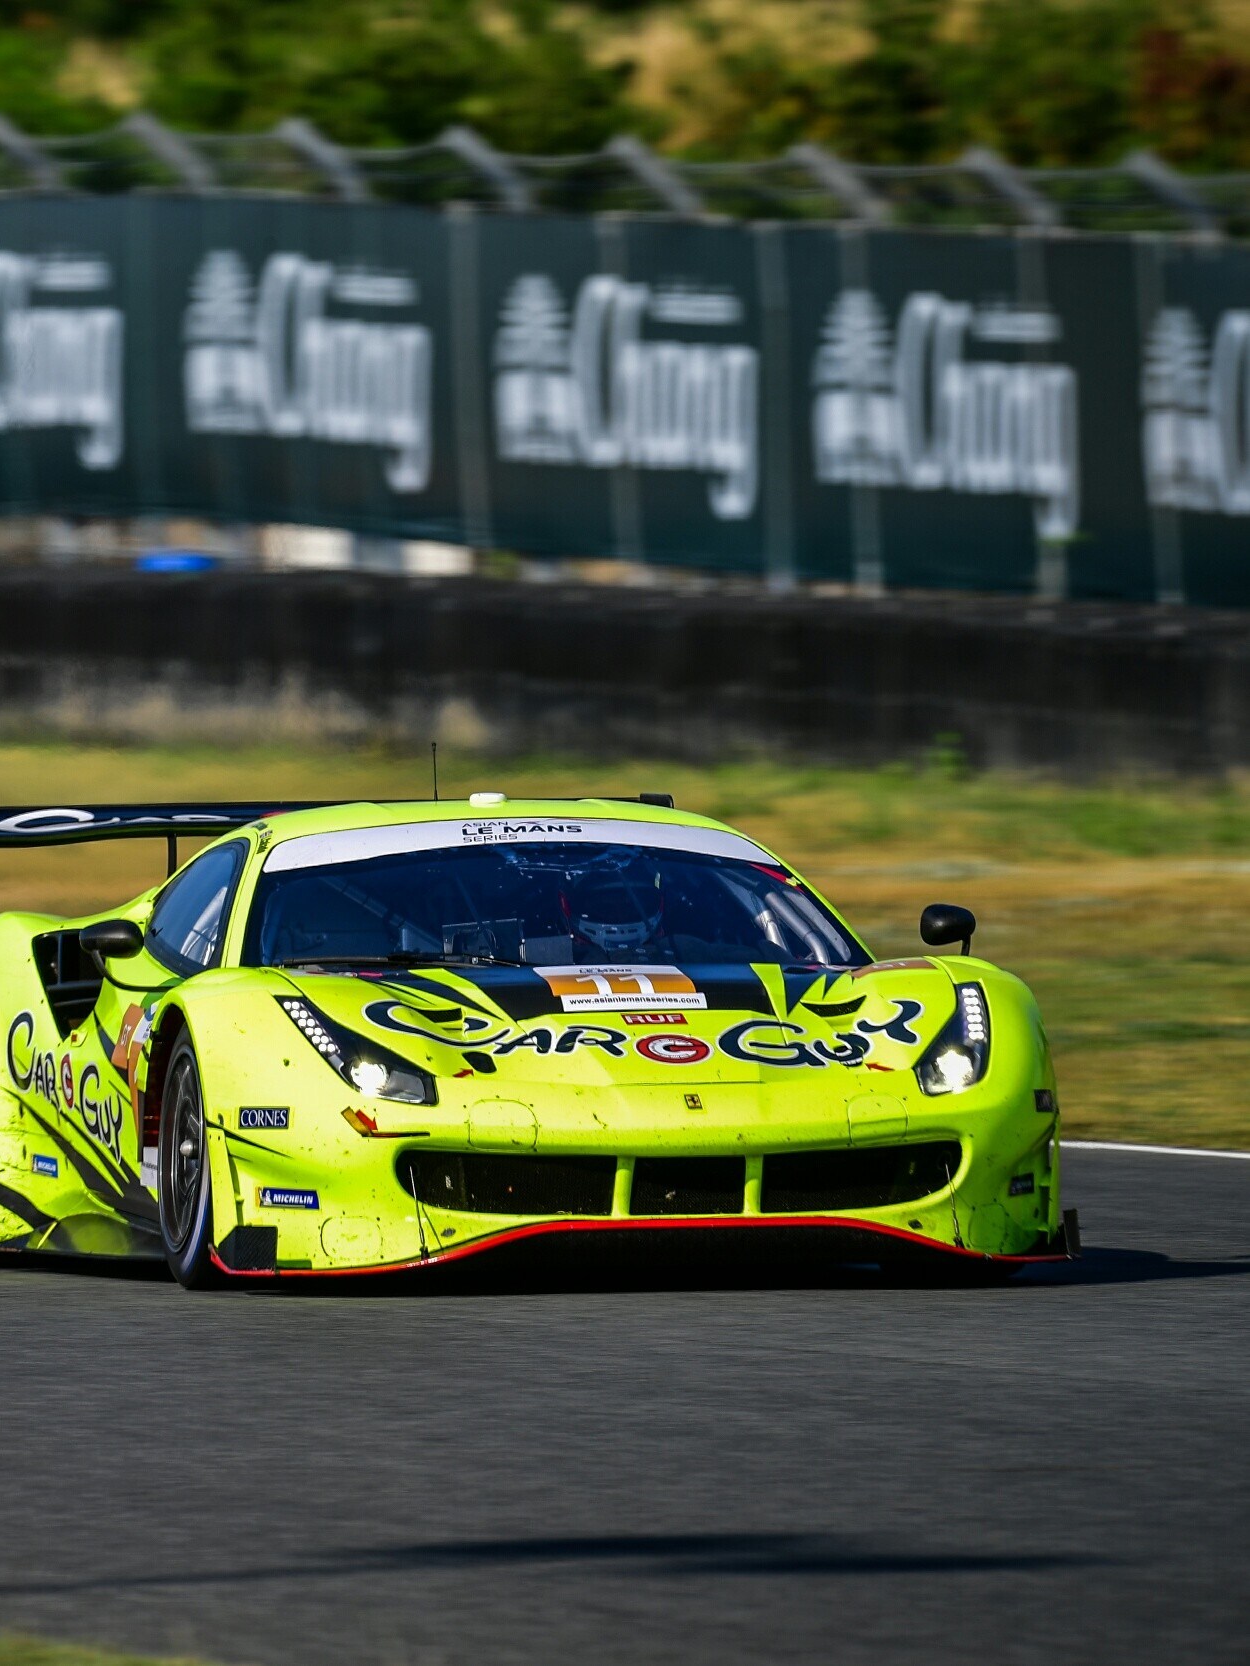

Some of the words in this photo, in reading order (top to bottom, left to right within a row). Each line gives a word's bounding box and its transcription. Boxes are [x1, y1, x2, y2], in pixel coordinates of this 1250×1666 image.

[462, 826, 493, 836] LE
[503, 825, 582, 833] MANS
[463, 834, 518, 843] SERIES
[575, 975, 656, 995] 11
[569, 995, 701, 1006] www.asianlemansseries.com
[626, 1014, 683, 1024] RUF
[240, 1109, 288, 1127] CORNES
[273, 1193, 314, 1205] MICHELIN
